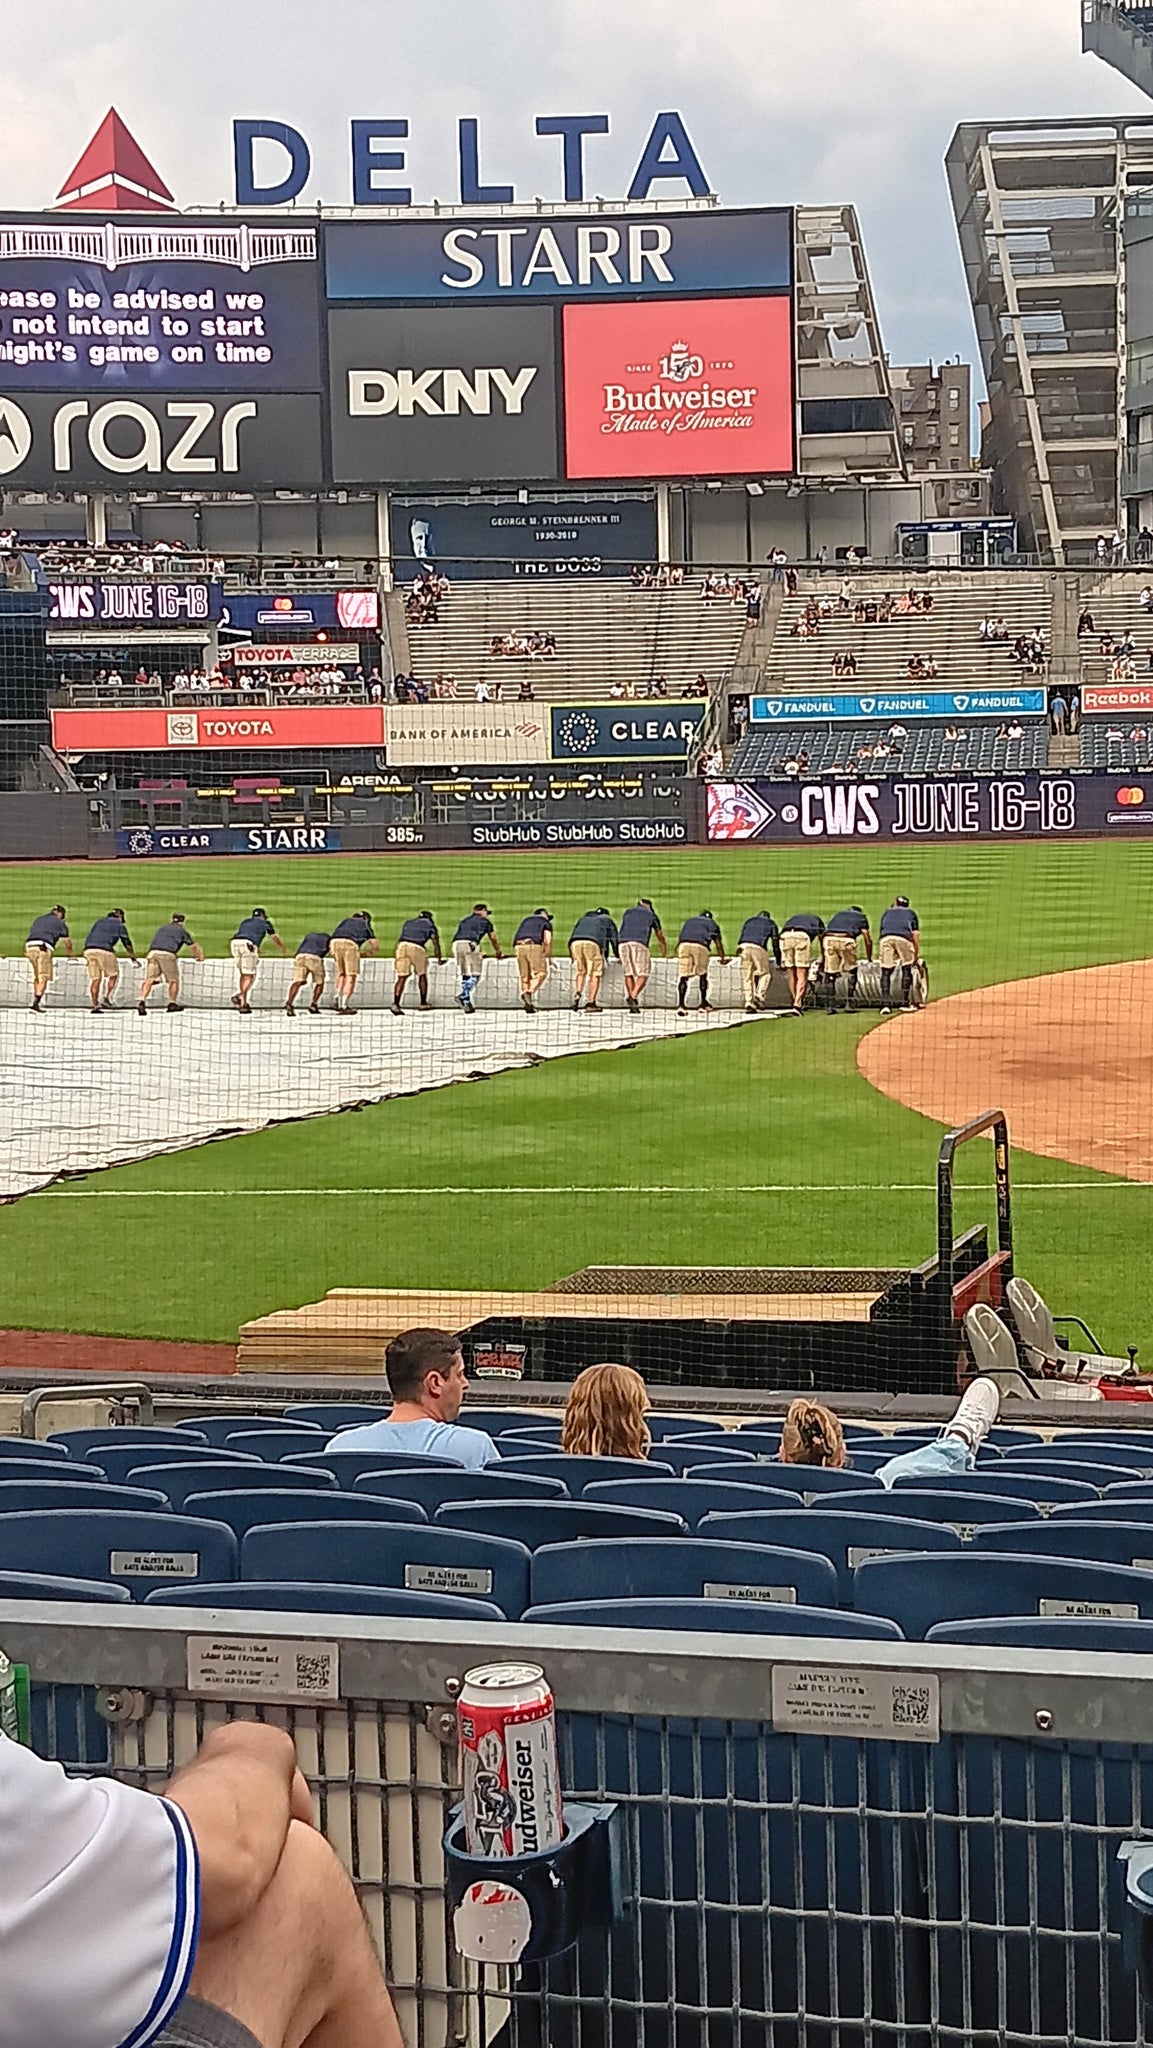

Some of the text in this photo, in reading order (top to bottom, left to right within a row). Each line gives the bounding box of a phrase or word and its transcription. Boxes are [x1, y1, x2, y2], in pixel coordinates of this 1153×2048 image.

[232, 112, 711, 206] DELTA
[441, 224, 674, 288] STARR
[67, 289, 101, 309] be
[113, 289, 214, 310] advised
[226, 294, 263, 309] we
[12, 315, 264, 336] not intend to start
[89, 346, 159, 366] game
[171, 347, 203, 362] on
[215, 342, 272, 362] time
[348, 367, 537, 416] DKNY
[603, 383, 757, 412] Budweiser
[601, 410, 753, 435] Made of America
[54, 401, 258, 473] razr
[491, 517, 526, 526] GEORGE
[542, 514, 608, 525] STEINBRENNER
[535, 531, 577, 540] 1930-2010
[101, 585, 153, 618] JUNE
[157, 585, 208, 618] 16-18
[237, 649, 293, 662] TOYOTA
[784, 697, 1023, 713] FANDUEL FANDUEL FANDUEL
[1085, 692, 1151, 706] Reebok
[203, 721, 274, 736] TOYOTA
[390, 728, 511, 740] BANK OF AMERICA
[611, 721, 694, 740] CLEAR
[340, 775, 401, 786] ARENA
[801, 785, 879, 835] CWS
[892, 783, 979, 834] JUNE
[989, 780, 1075, 831] 16-18
[160, 835, 210, 848] CLEAR
[248, 829, 326, 849] STARR
[473, 823, 685, 843] StubHub StubHub StubHub
[511, 1740, 539, 1857] udweiser
